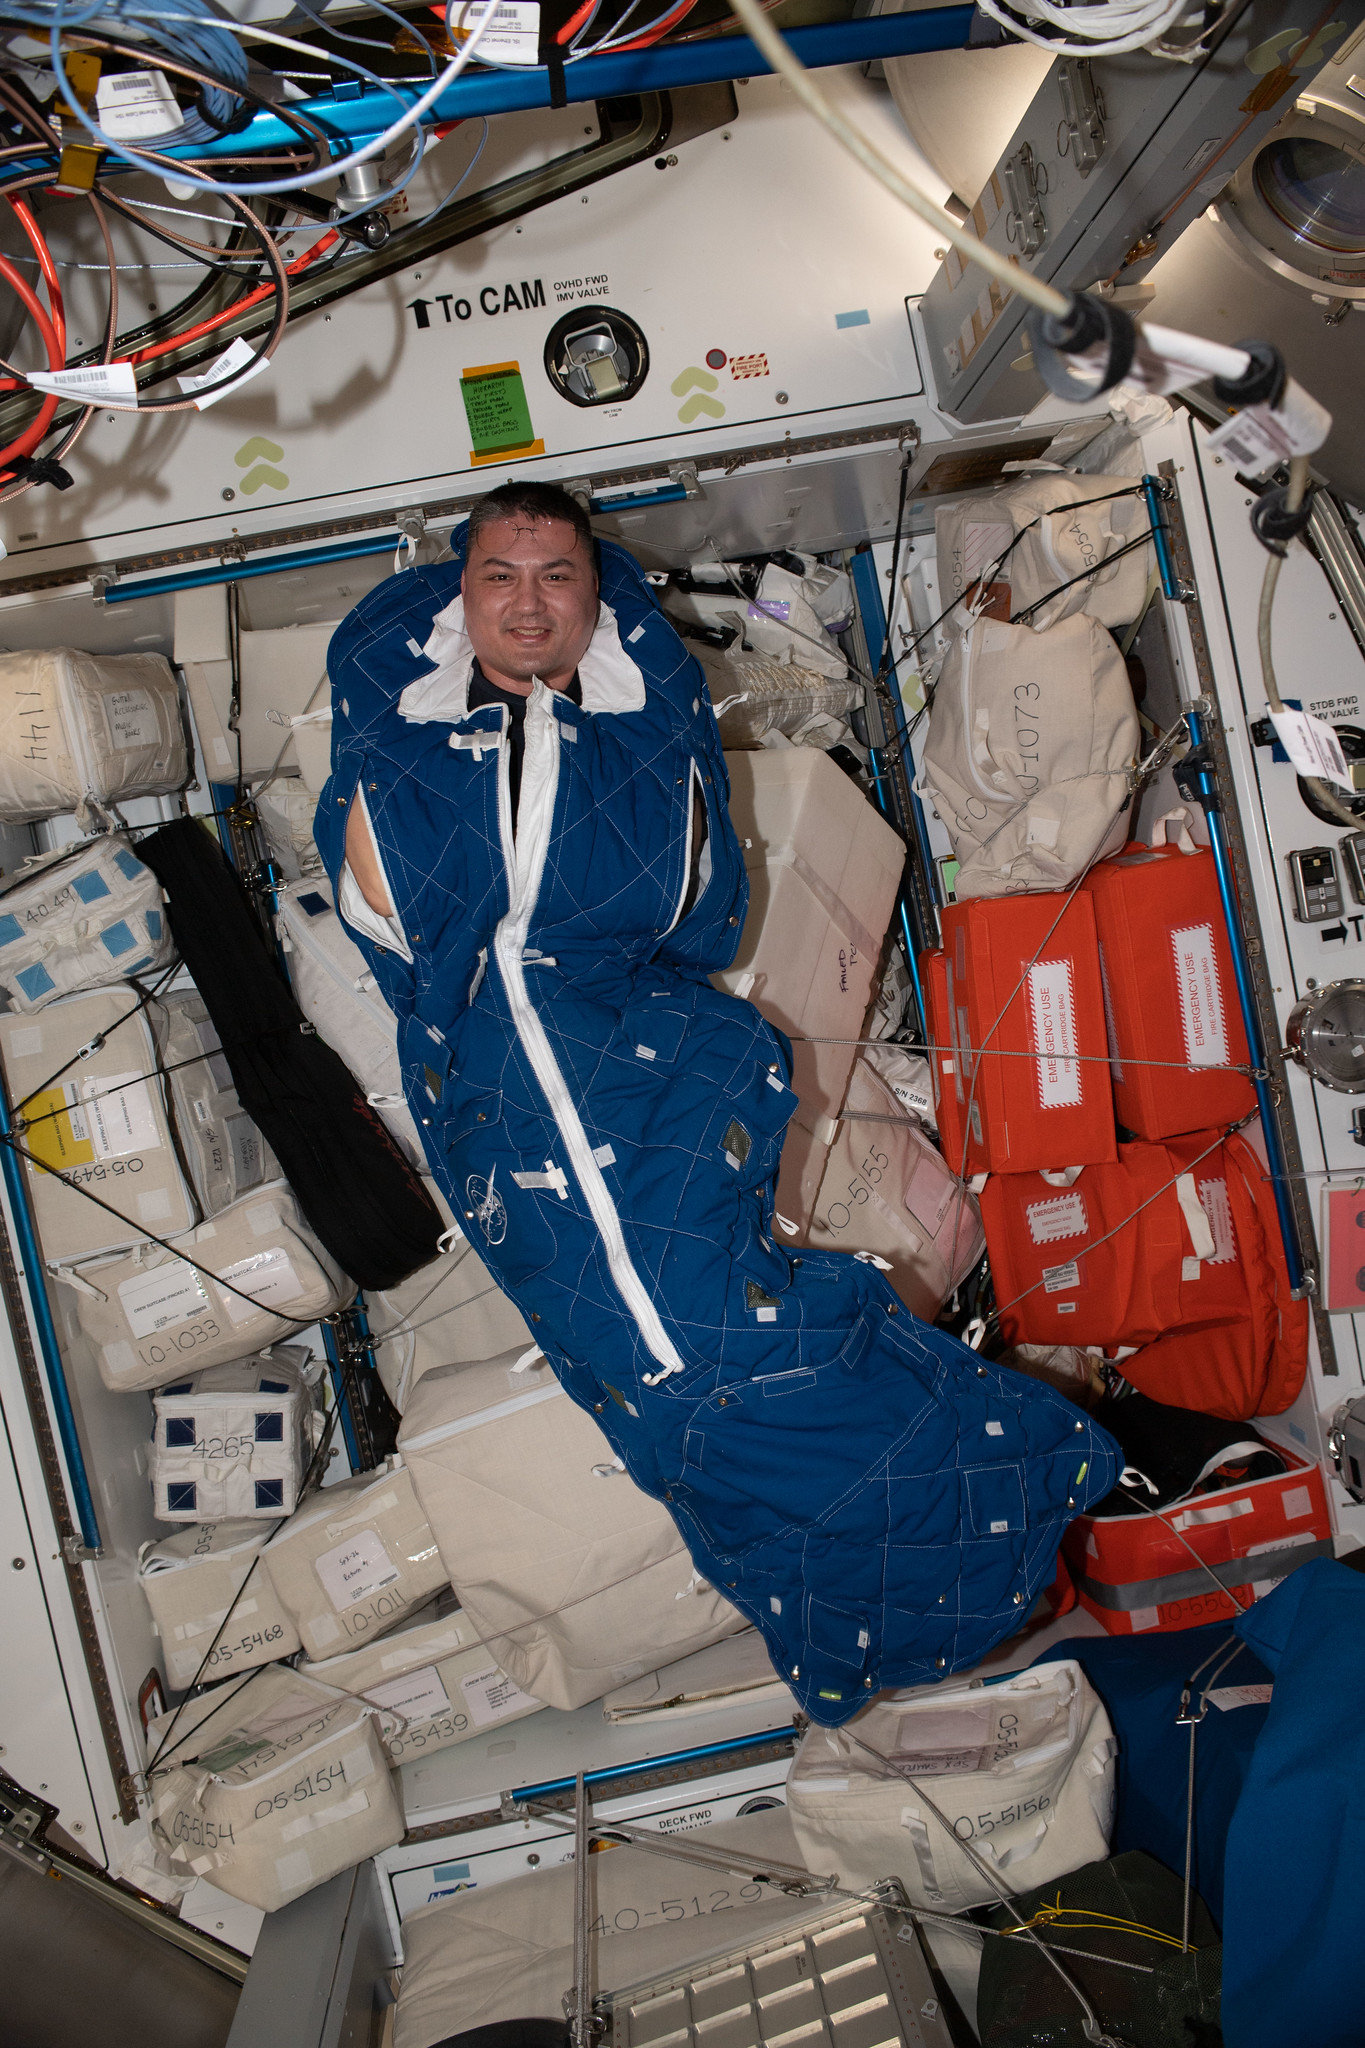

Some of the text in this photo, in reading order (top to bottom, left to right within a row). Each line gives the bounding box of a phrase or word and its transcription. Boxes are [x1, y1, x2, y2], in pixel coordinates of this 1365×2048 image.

[553, 274, 608, 290] OVHD FWD
[556, 286, 610, 302] IMV VALVE
[436, 279, 546, 322] To CAM
[1310, 696, 1358, 710] STDB FWD
[1312, 706, 1360, 720] MV VALVE
[16, 692, 50, 760] 1144
[1348, 914, 1365, 942] T
[838, 949, 848, 992] FAILED
[1184, 952, 1205, 1046] EMERGENCY USE
[1201, 957, 1218, 1036] FIRE CARTRIDGE BAG
[1040, 986, 1058, 1083] EMERGENCY USE
[1058, 1010, 1070, 1054] CARTRIDGE
[894, 1087, 928, 1106] S/N 2368
[96, 1117, 104, 1129] BAG
[98, 1130, 110, 1151] SLEEPING
[206, 1128, 222, 1170] S/N 1227
[819, 1144, 889, 1238] 1.0-5155
[1033, 1202, 1076, 1218] EMERGENCY USE
[220, 1274, 233, 1282] REW
[134, 1304, 146, 1314] CREW
[146, 1296, 166, 1308] SUITCASE
[138, 1319, 220, 1366] 1.0-1033
[192, 1435, 254, 1458] 4265
[343, 1568, 362, 1581] Return
[342, 1588, 406, 1637] 1.0-1011
[208, 1624, 284, 1665] 0.5-5468
[465, 1678, 480, 1688] CREW
[254, 1760, 347, 1820] 0.5-5154
[658, 1814, 688, 1830] DECK
[688, 1810, 712, 1824] FWD
[954, 1795, 1050, 1842] 0.5-5156
[587, 1883, 762, 1937] 4.0-5129
